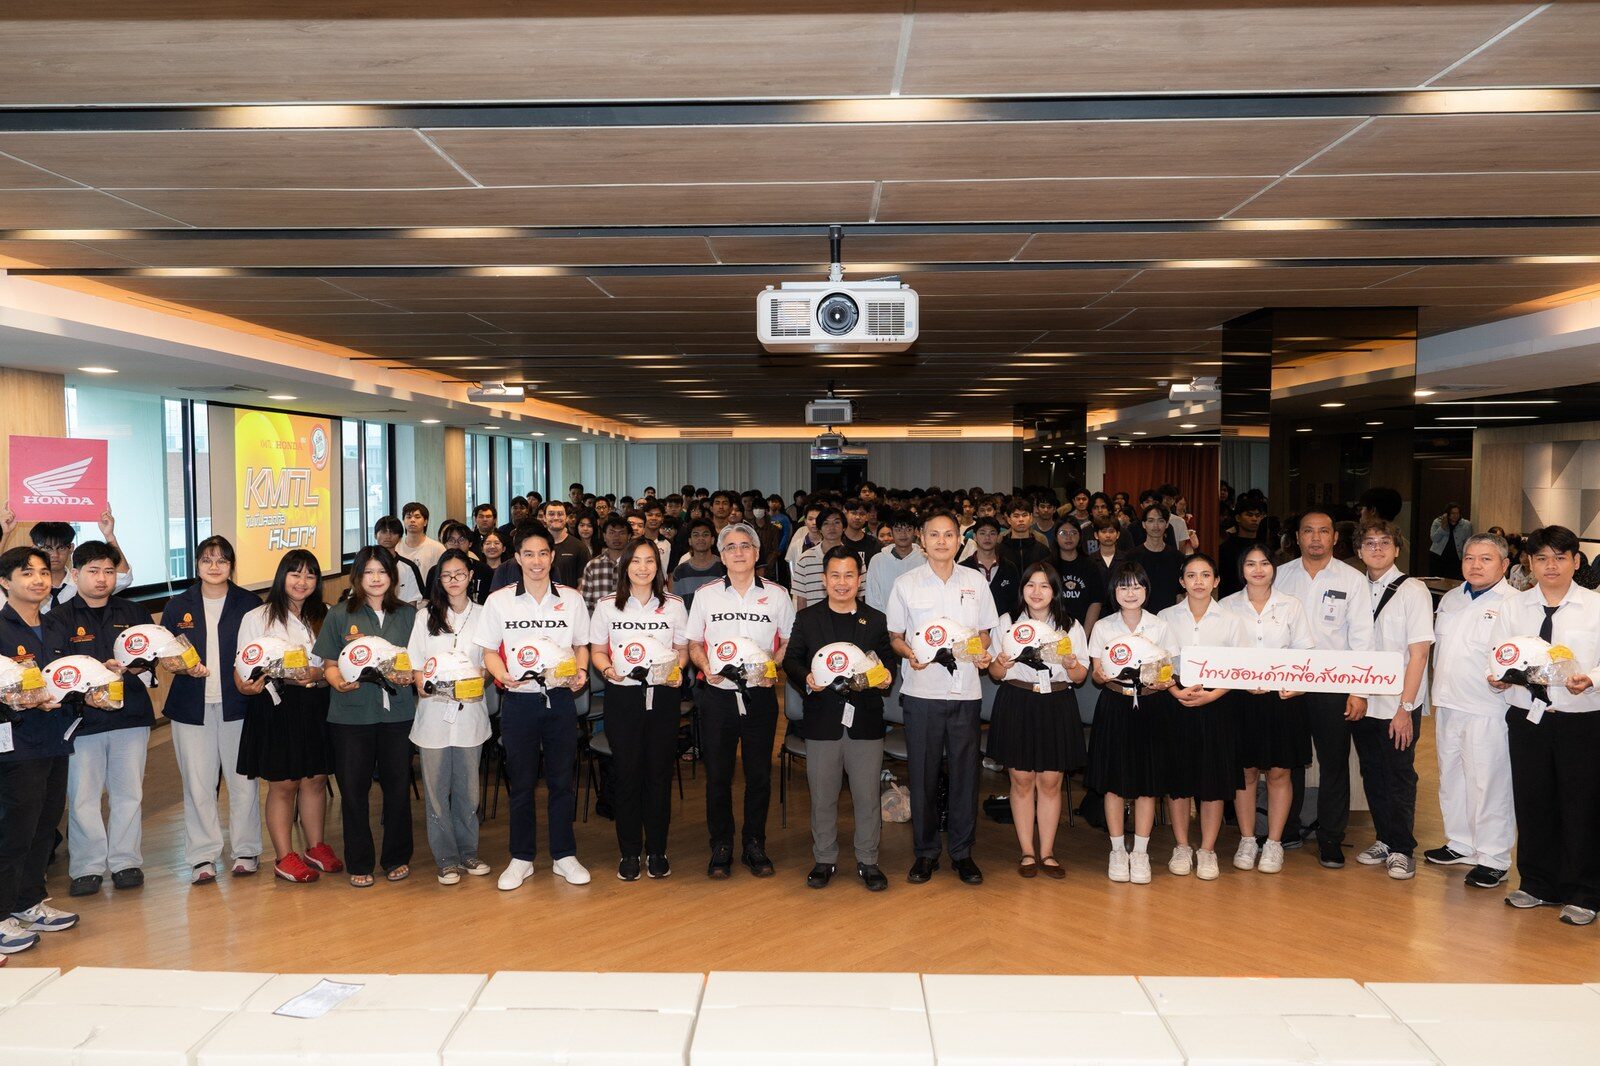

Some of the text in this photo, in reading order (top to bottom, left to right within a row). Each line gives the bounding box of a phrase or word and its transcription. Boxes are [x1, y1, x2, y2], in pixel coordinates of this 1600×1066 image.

[23, 495, 95, 506] HONDA
[711, 612, 772, 623] HONDA
[504, 620, 569, 629] HONDA
[611, 621, 670, 630] HONDA
[1187, 658, 1397, 685] ไทยฮอนด้าเพื่อสังคมไทย
